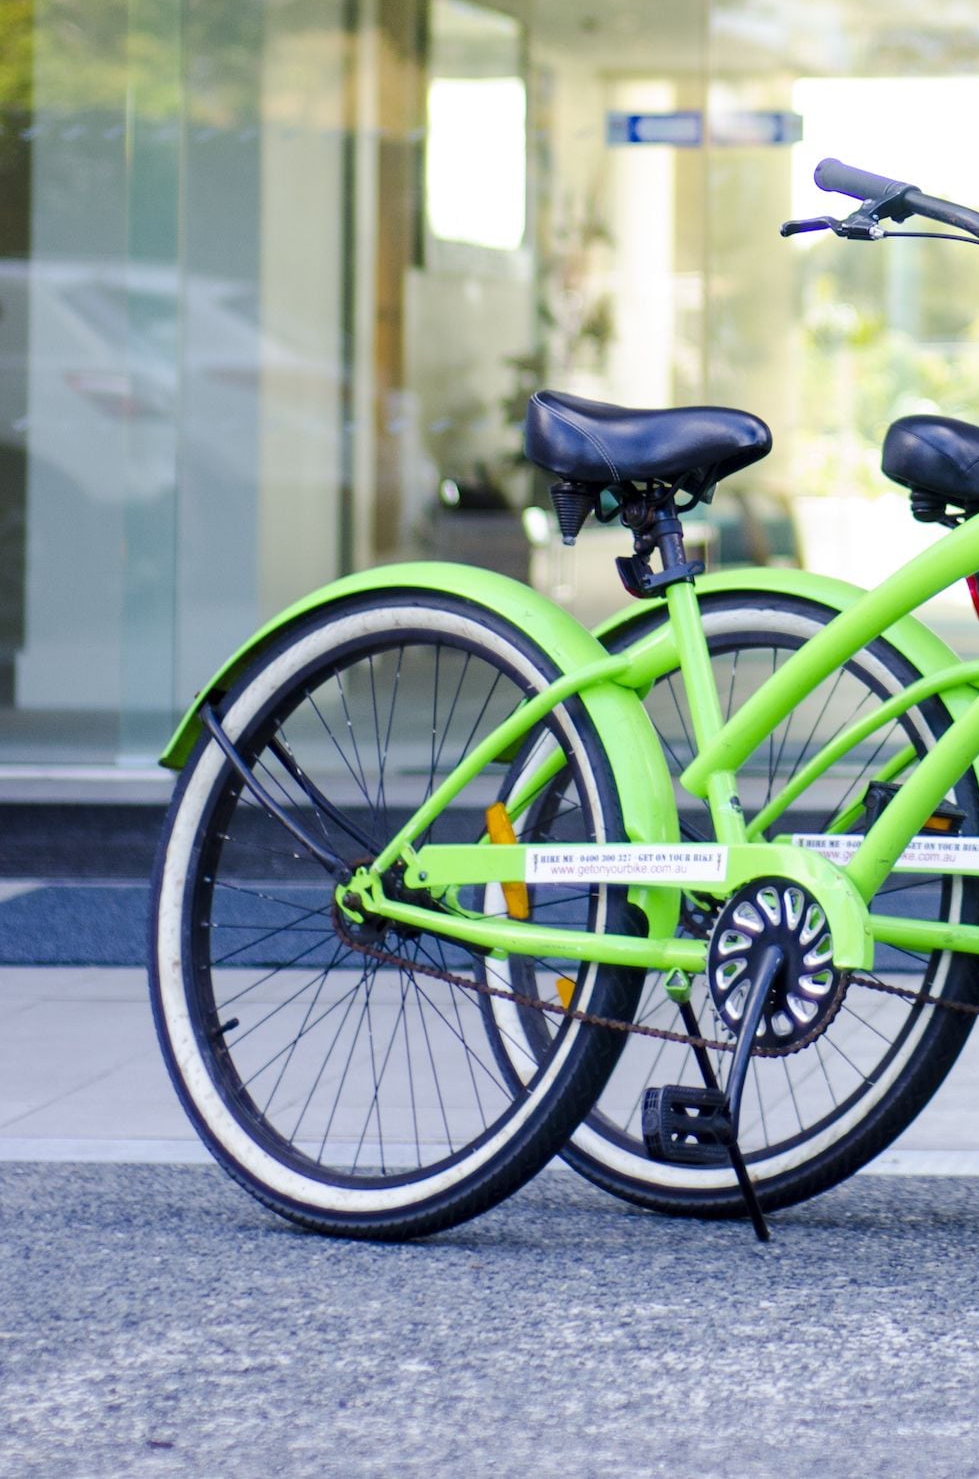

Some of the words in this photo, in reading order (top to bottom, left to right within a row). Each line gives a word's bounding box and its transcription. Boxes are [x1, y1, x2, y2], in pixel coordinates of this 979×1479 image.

[829, 840, 840, 848] ME
[924, 842, 935, 850] ON
[938, 843, 960, 851] YOUR
[563, 855, 573, 863] ME
[638, 853, 654, 862] GET
[655, 853, 666, 862] ON
[669, 853, 690, 862] YOUR
[693, 853, 713, 862] BIKE
[551, 863, 687, 877] www.getonyourbike.com.au
